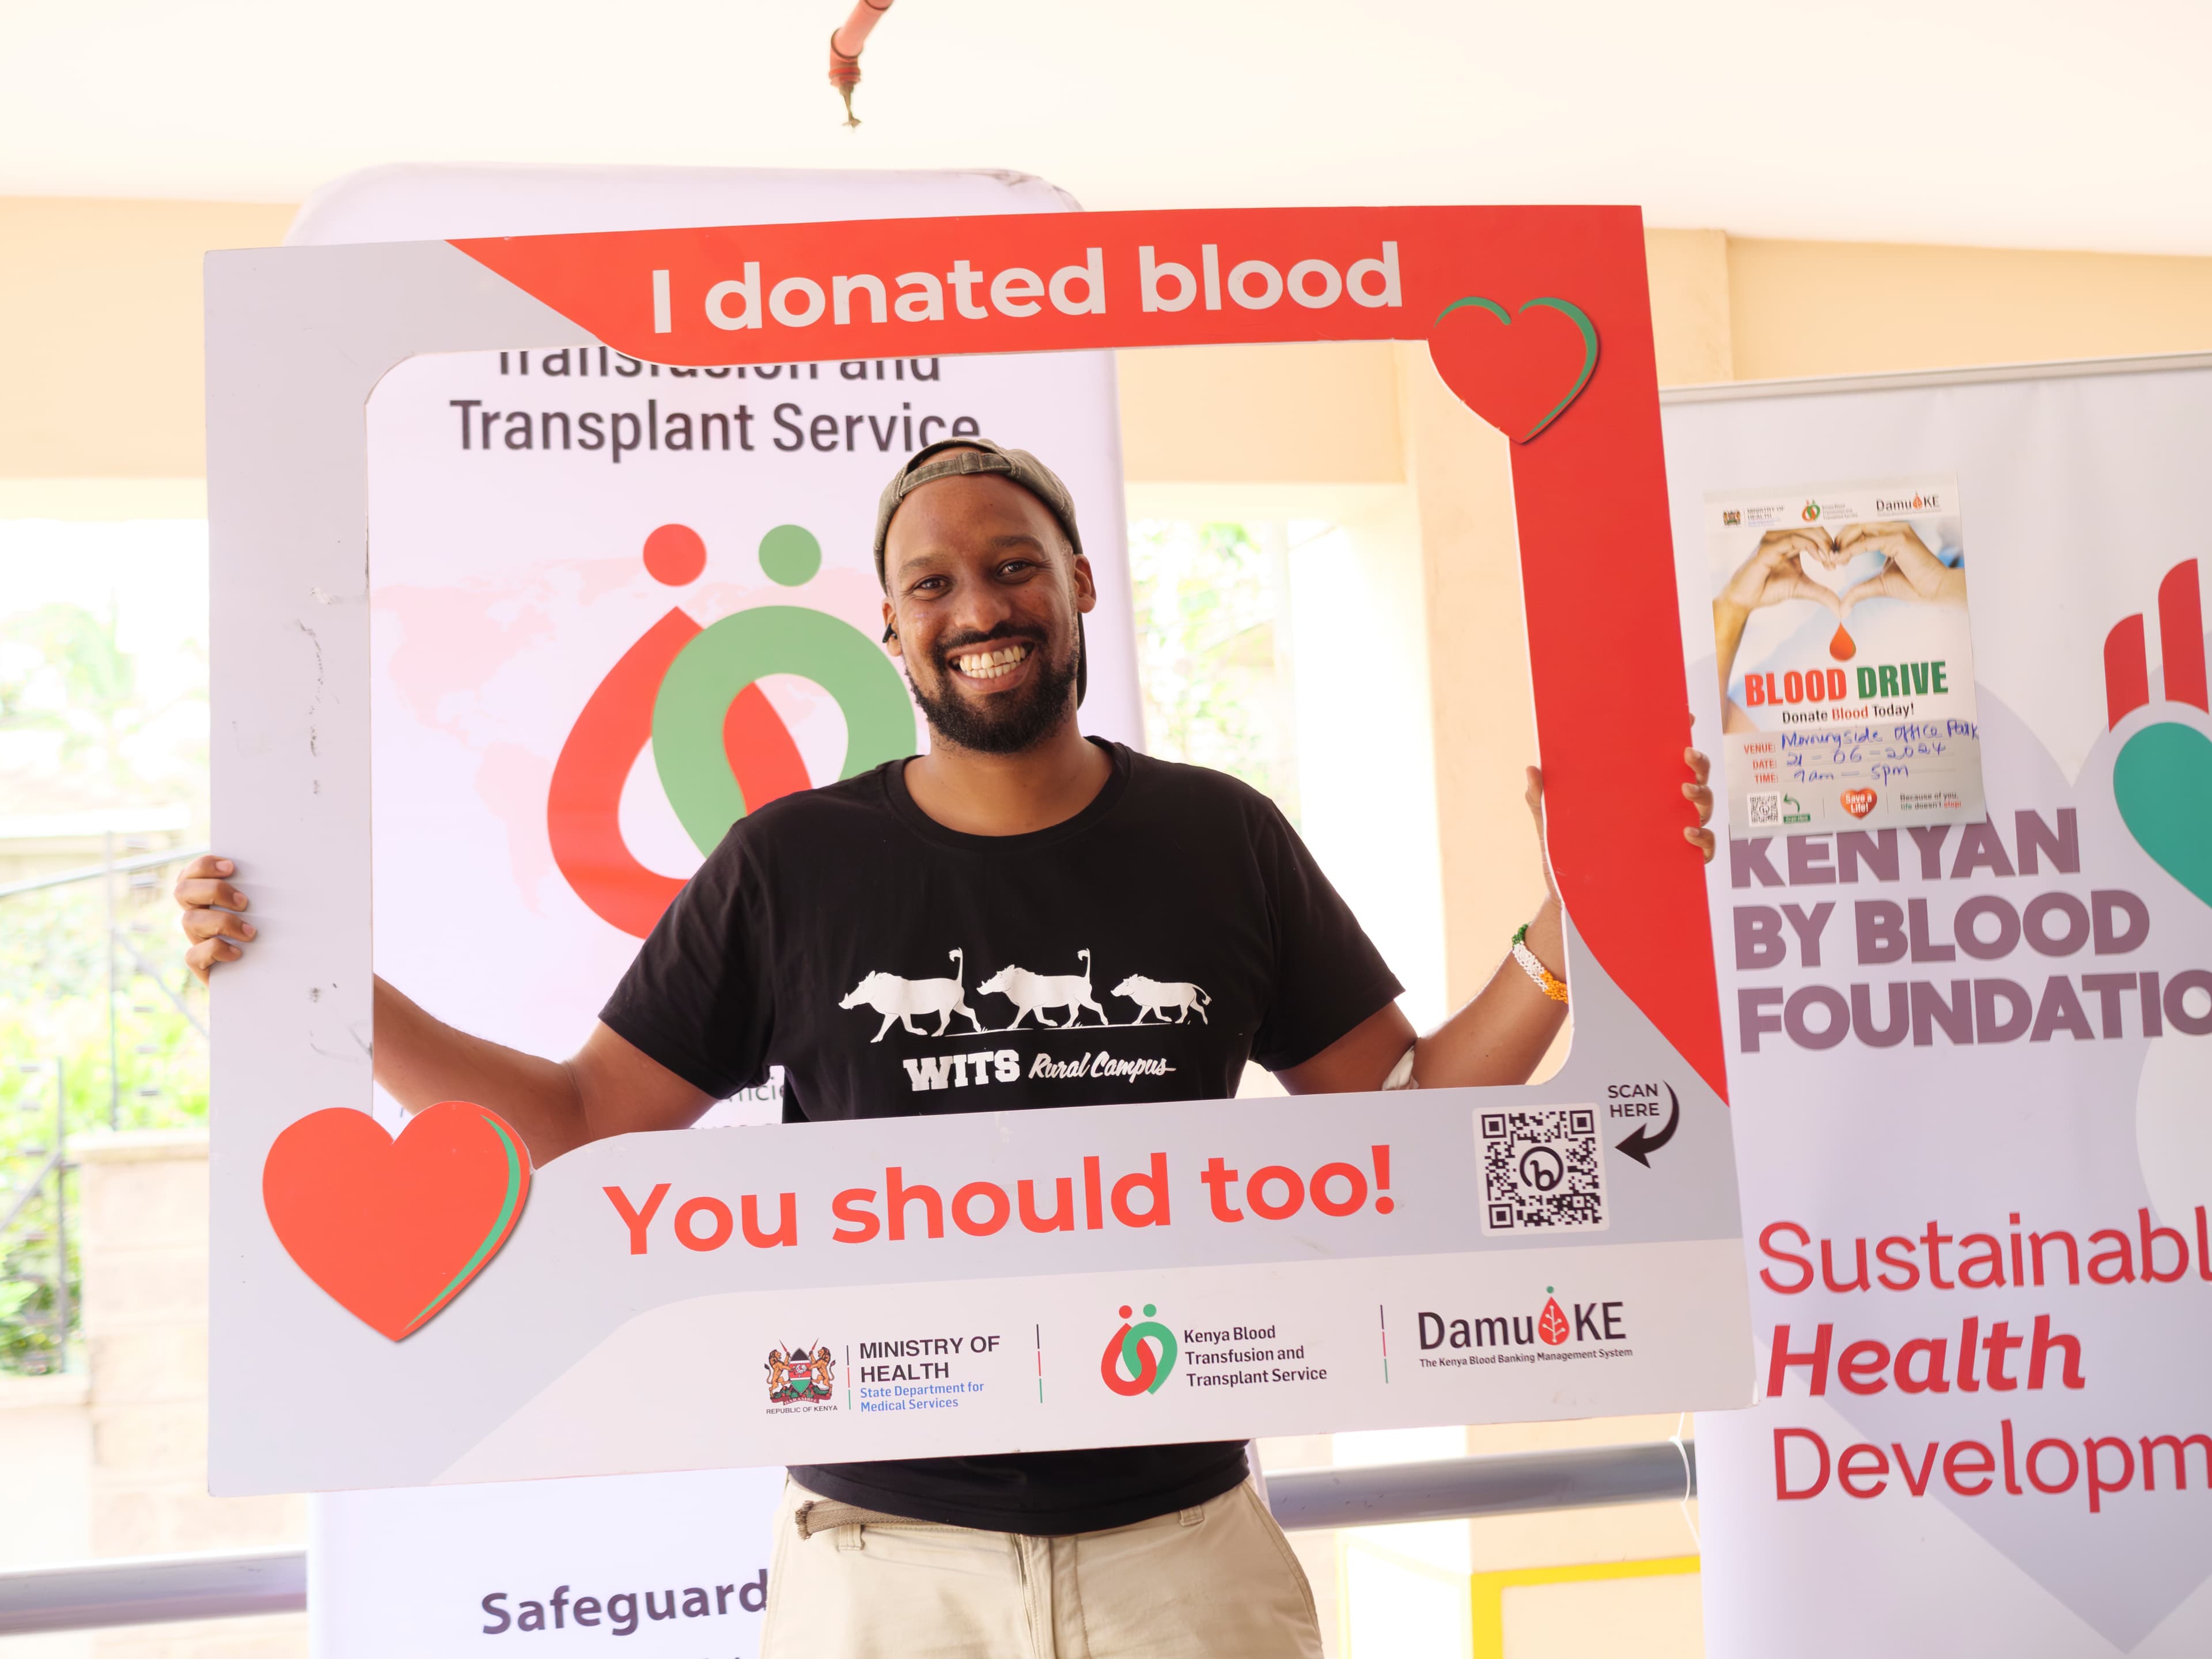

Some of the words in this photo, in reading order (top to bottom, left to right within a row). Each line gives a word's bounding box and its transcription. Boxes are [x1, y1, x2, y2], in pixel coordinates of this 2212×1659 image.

[653, 270, 672, 334] I
[705, 248, 1106, 331] donated
[1139, 241, 1402, 313] blood
[450, 400, 754, 463] Transplant
[773, 402, 980, 452] Service
[1745, 669, 1847, 707] BLOOD
[1857, 661, 1948, 700] DRIVE
[1782, 710, 1828, 724] Donate
[1832, 706, 1868, 720] Blood
[1873, 703, 1914, 719] Today!
[1947, 719, 1979, 740] Park
[1744, 743, 1775, 754] VENUE:
[1753, 760, 1777, 770] DATE:
[1755, 774, 1778, 783] TIME:
[1845, 793, 1865, 805] Save
[1850, 802, 1868, 813] Life!
[1730, 808, 2081, 889] KENYAN
[1733, 902, 1836, 971] BY
[1854, 889, 2149, 966] BLOOD
[903, 1050, 1020, 1092] WITS
[1028, 1052, 1091, 1080] Rural
[1090, 1051, 1176, 1083] Campus
[1608, 1083, 1658, 1099] SCAN
[1610, 1103, 1660, 1118] HERE
[602, 1183, 797, 1255] You
[832, 1152, 1171, 1243] should
[1200, 1145, 1394, 1222] too!
[1184, 1330, 1230, 1345] Kenya
[1233, 1325, 1275, 1340] Blood
[860, 1338, 963, 1359] MINISTRY
[970, 1335, 1000, 1353] OF
[1185, 1347, 1274, 1365] Transfusion
[1277, 1345, 1305, 1360] and
[1766, 1313, 2085, 1398] Health
[1419, 1358, 1437, 1368] The
[1439, 1357, 1468, 1368] Kenya
[1469, 1355, 1496, 1365] Blood
[1498, 1353, 1535, 1365] Banking
[1537, 1350, 1597, 1362] Management
[1599, 1348, 1633, 1359] System
[861, 1362, 949, 1382] HEALTH
[1186, 1370, 1269, 1388] Transplant
[1272, 1366, 1327, 1382] Service
[861, 1387, 891, 1398] State
[895, 1382, 965, 1397] Department
[968, 1381, 984, 1392] for
[861, 1400, 906, 1412] Medical
[909, 1398, 959, 1410] Services
